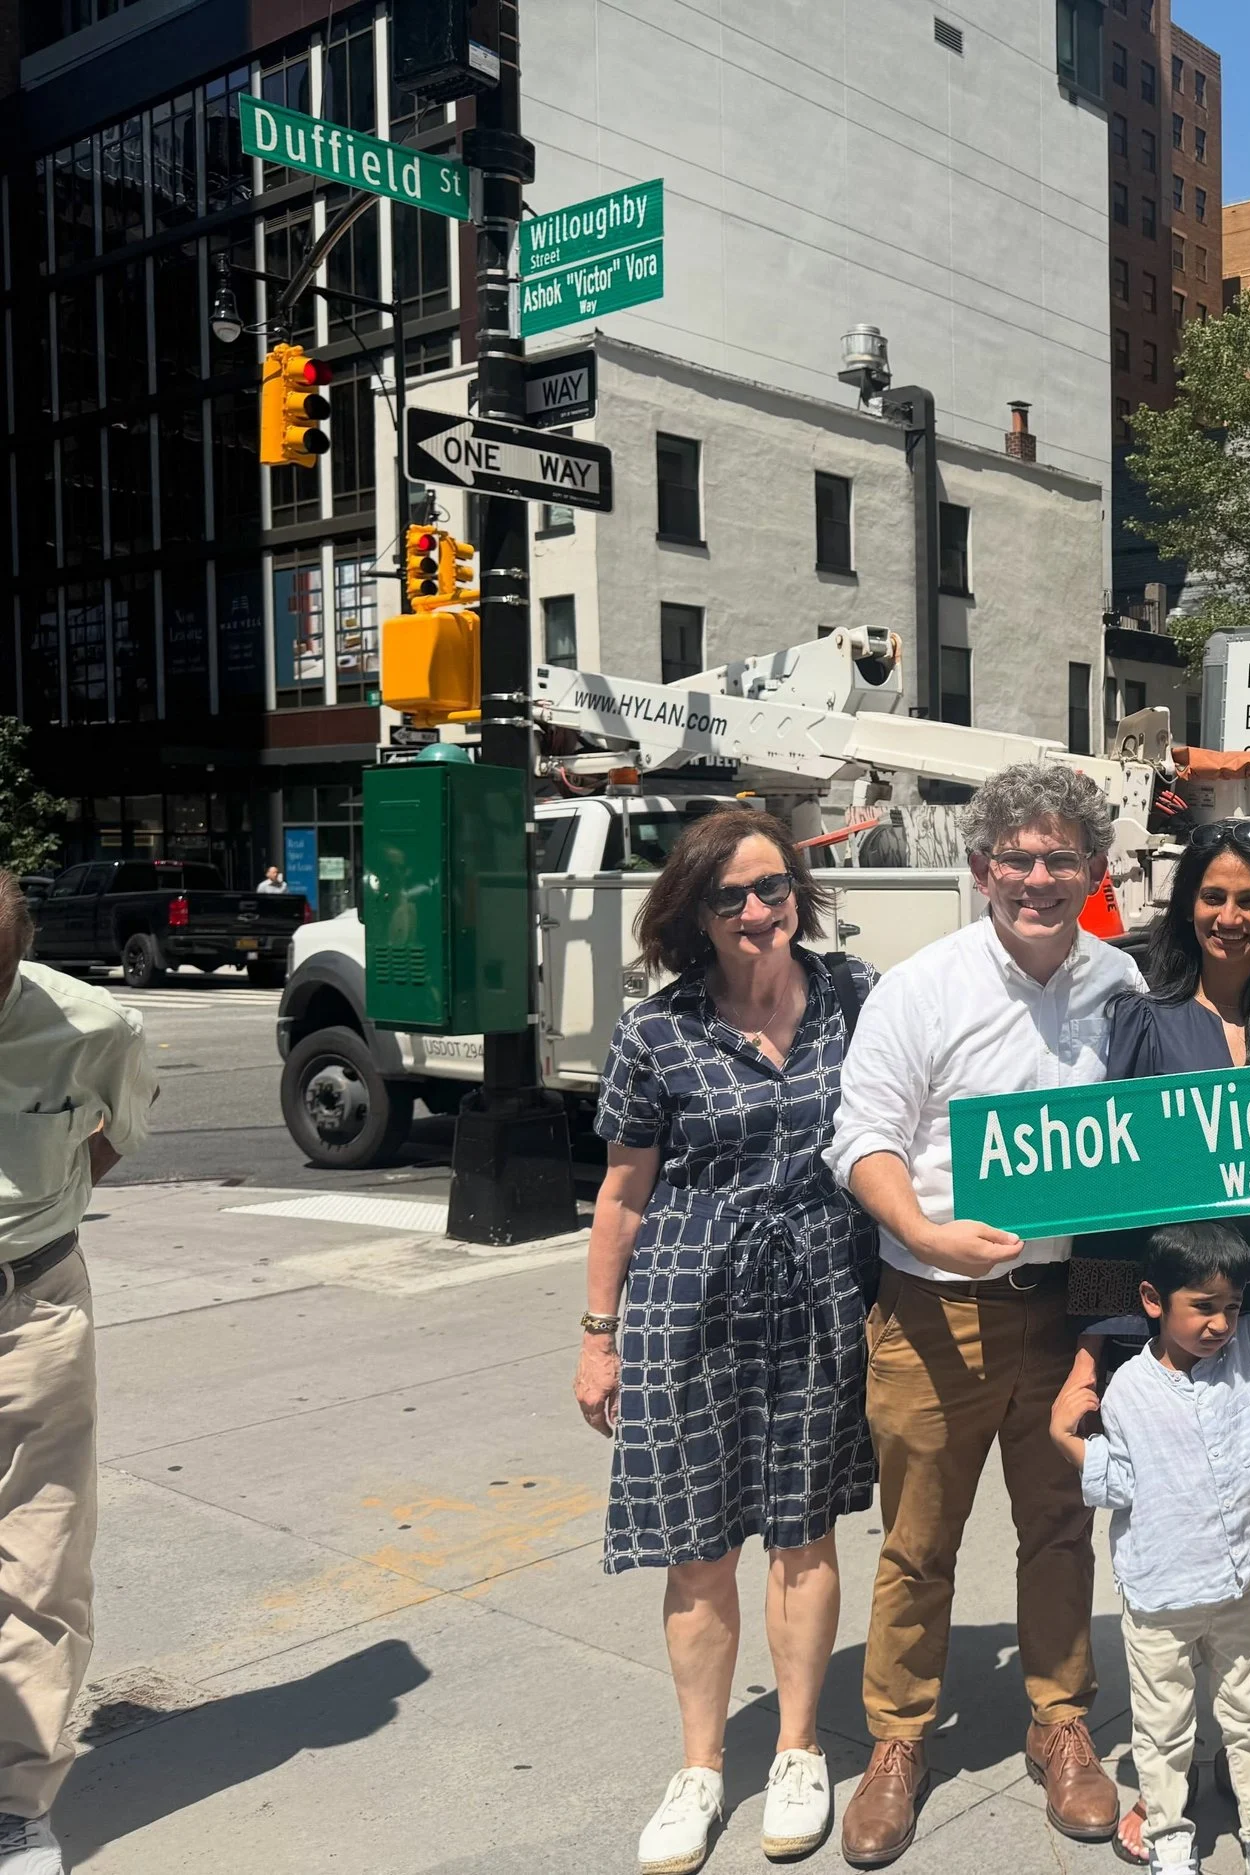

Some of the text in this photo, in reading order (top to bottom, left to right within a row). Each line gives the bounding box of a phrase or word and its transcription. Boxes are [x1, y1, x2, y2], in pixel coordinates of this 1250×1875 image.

[254, 107, 462, 199] Duffield St
[530, 194, 647, 251] Willoughby
[530, 248, 560, 270] Street
[523, 253, 657, 314] Ashok "Victor" Vora
[579, 299, 597, 314] Way
[542, 373, 583, 407] WAY
[443, 436, 591, 487] ONE WAY
[574, 691, 727, 736] www.HYLAN.com
[424, 1039, 461, 1057] USDOT
[978, 1096, 1140, 1180] Ashok
